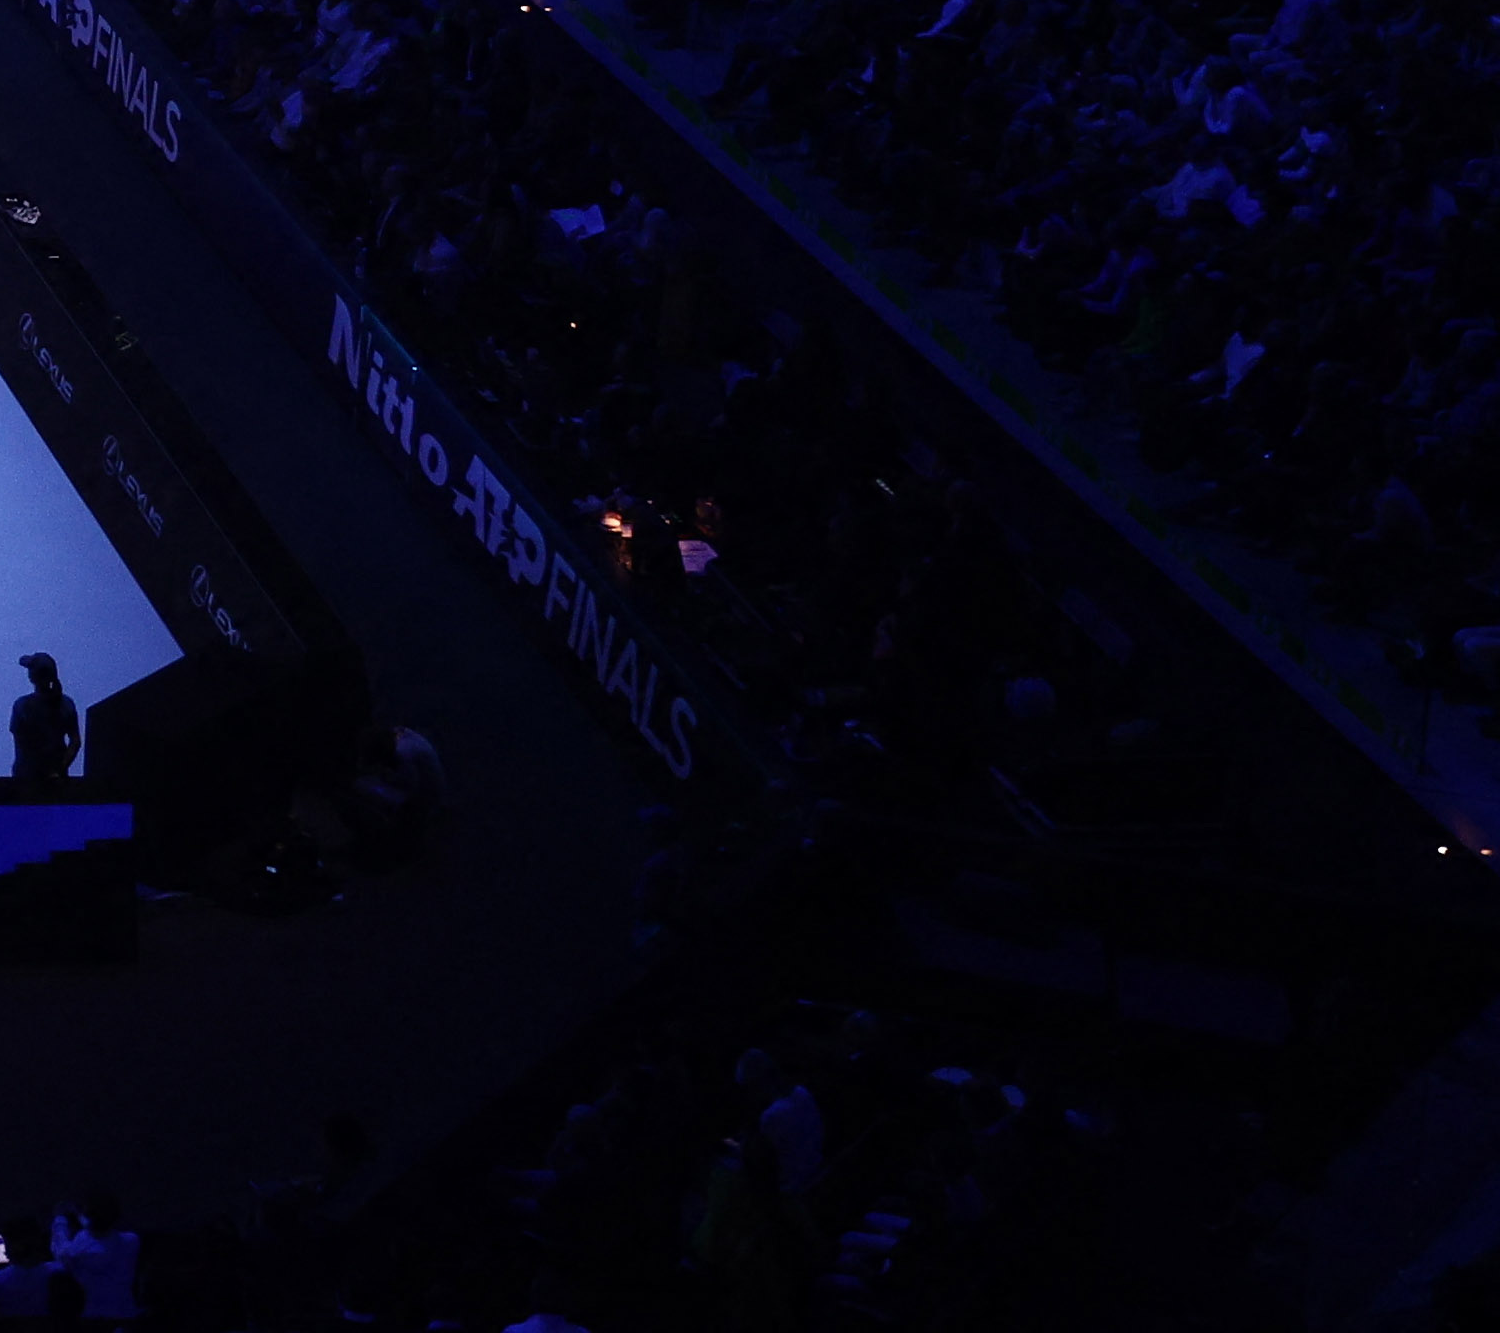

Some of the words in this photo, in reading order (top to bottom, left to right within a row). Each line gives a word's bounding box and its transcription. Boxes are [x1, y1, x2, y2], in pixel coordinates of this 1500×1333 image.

[91, 13, 182, 164] FINALS
[326, 291, 453, 491] Nitto
[452, 453, 548, 589] ATP
[543, 554, 699, 782] FINALS
